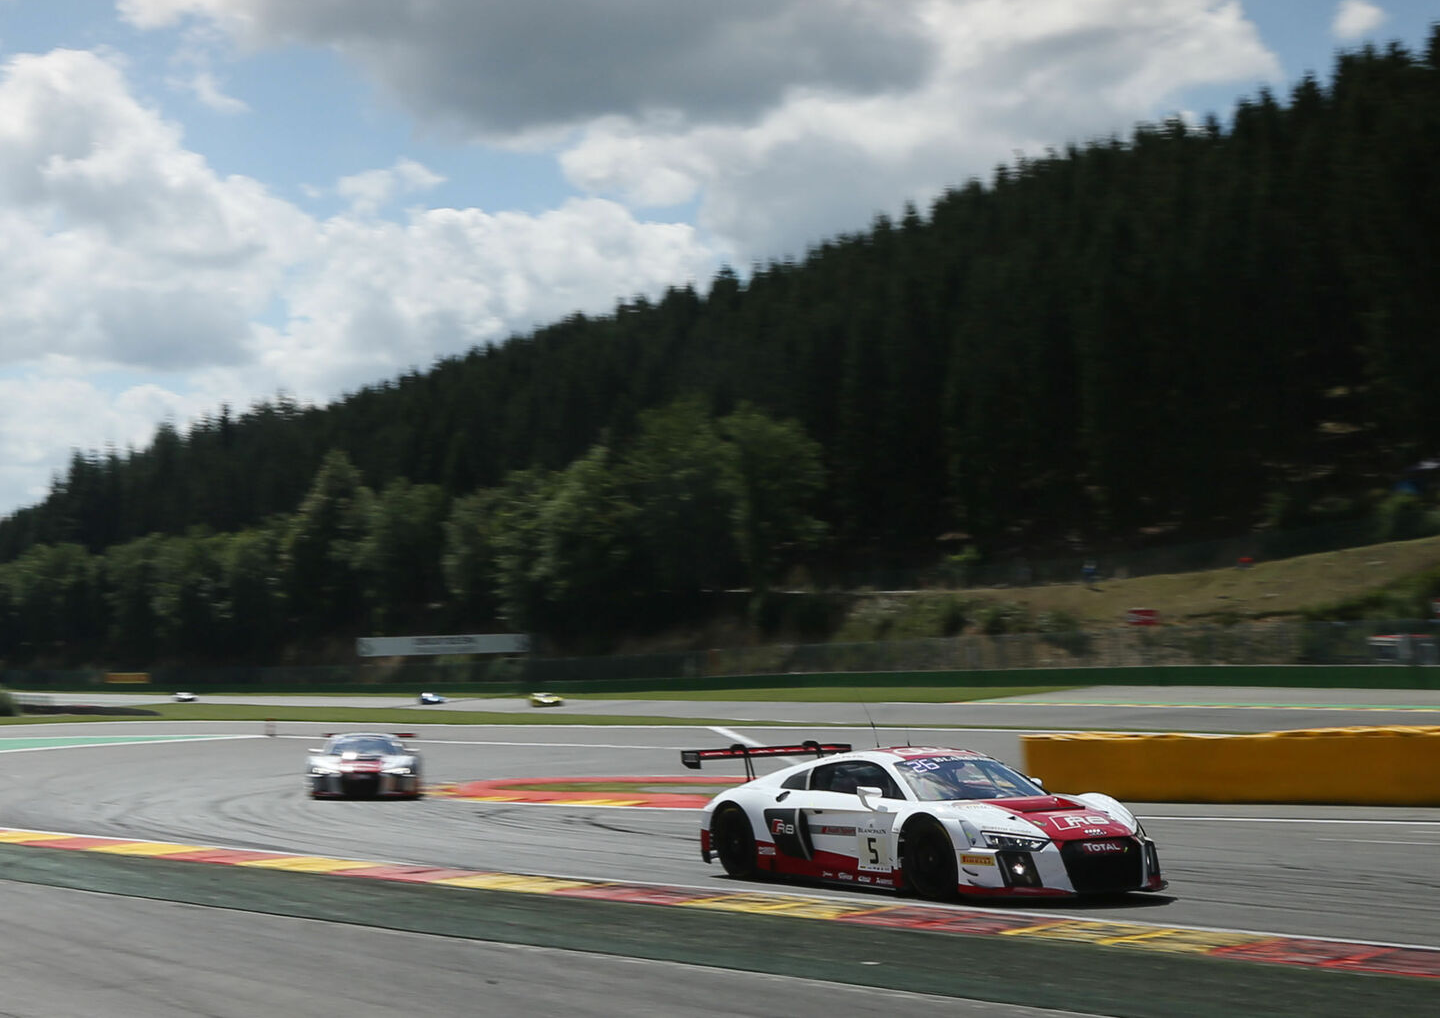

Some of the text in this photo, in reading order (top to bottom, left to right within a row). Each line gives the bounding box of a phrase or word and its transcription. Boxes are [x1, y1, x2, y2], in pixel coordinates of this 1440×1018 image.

[904, 759, 940, 773] 26
[774, 820, 794, 834] R8
[1058, 815, 1111, 828] R8
[867, 837, 879, 864] 5
